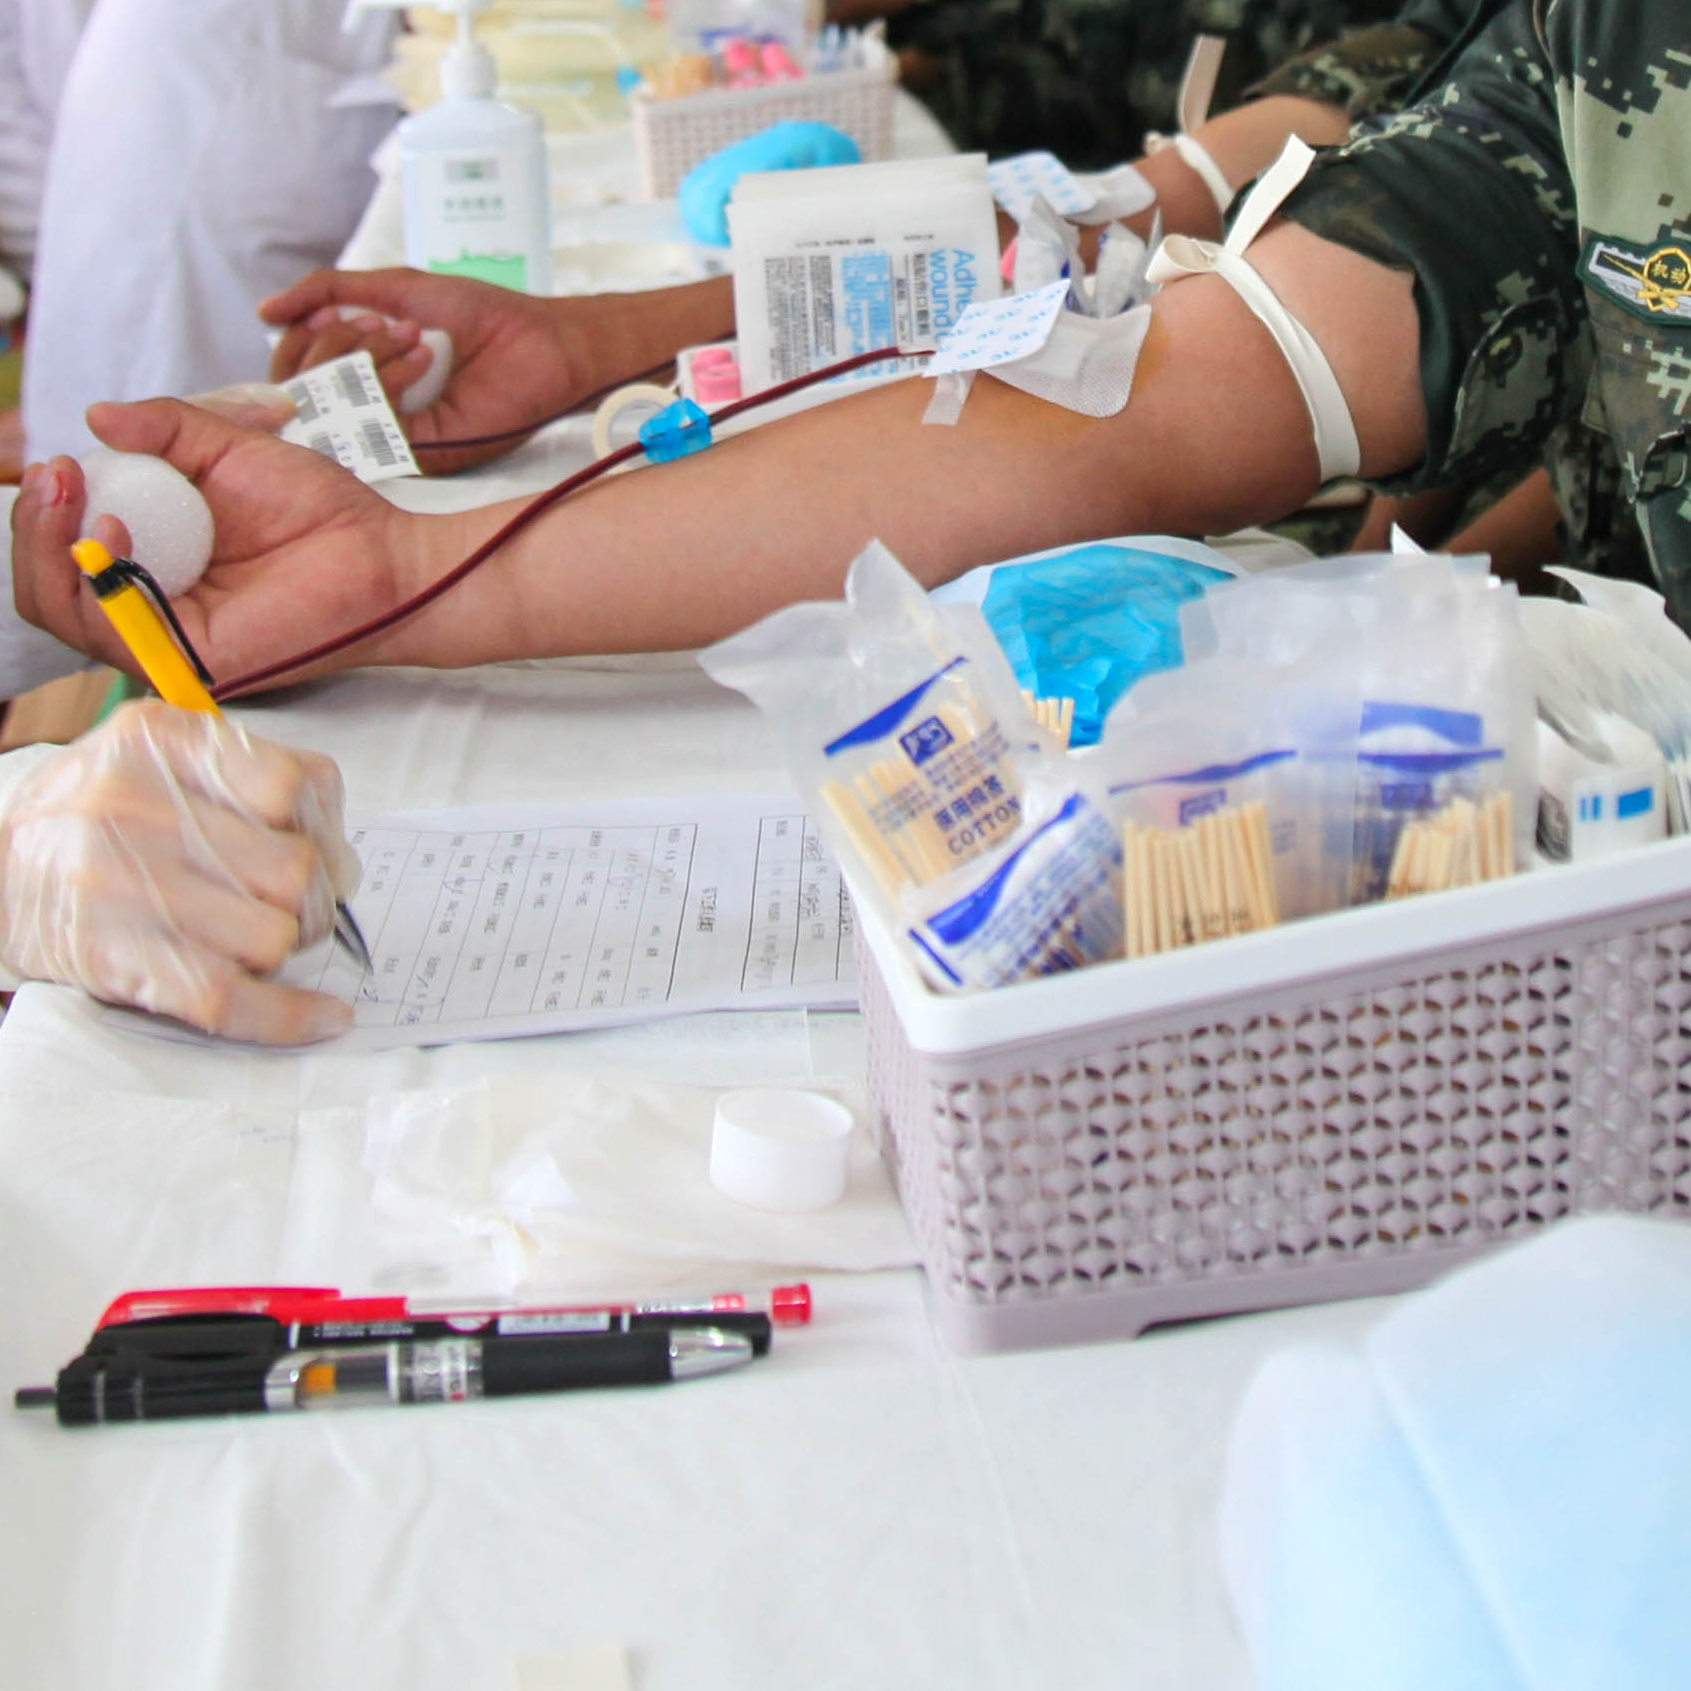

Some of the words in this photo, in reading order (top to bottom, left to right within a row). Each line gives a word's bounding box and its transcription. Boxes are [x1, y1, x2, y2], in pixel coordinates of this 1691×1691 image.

[930, 249, 953, 328] wound
[1651, 259, 1687, 285] 机动
[947, 796, 1020, 855] COTTON
